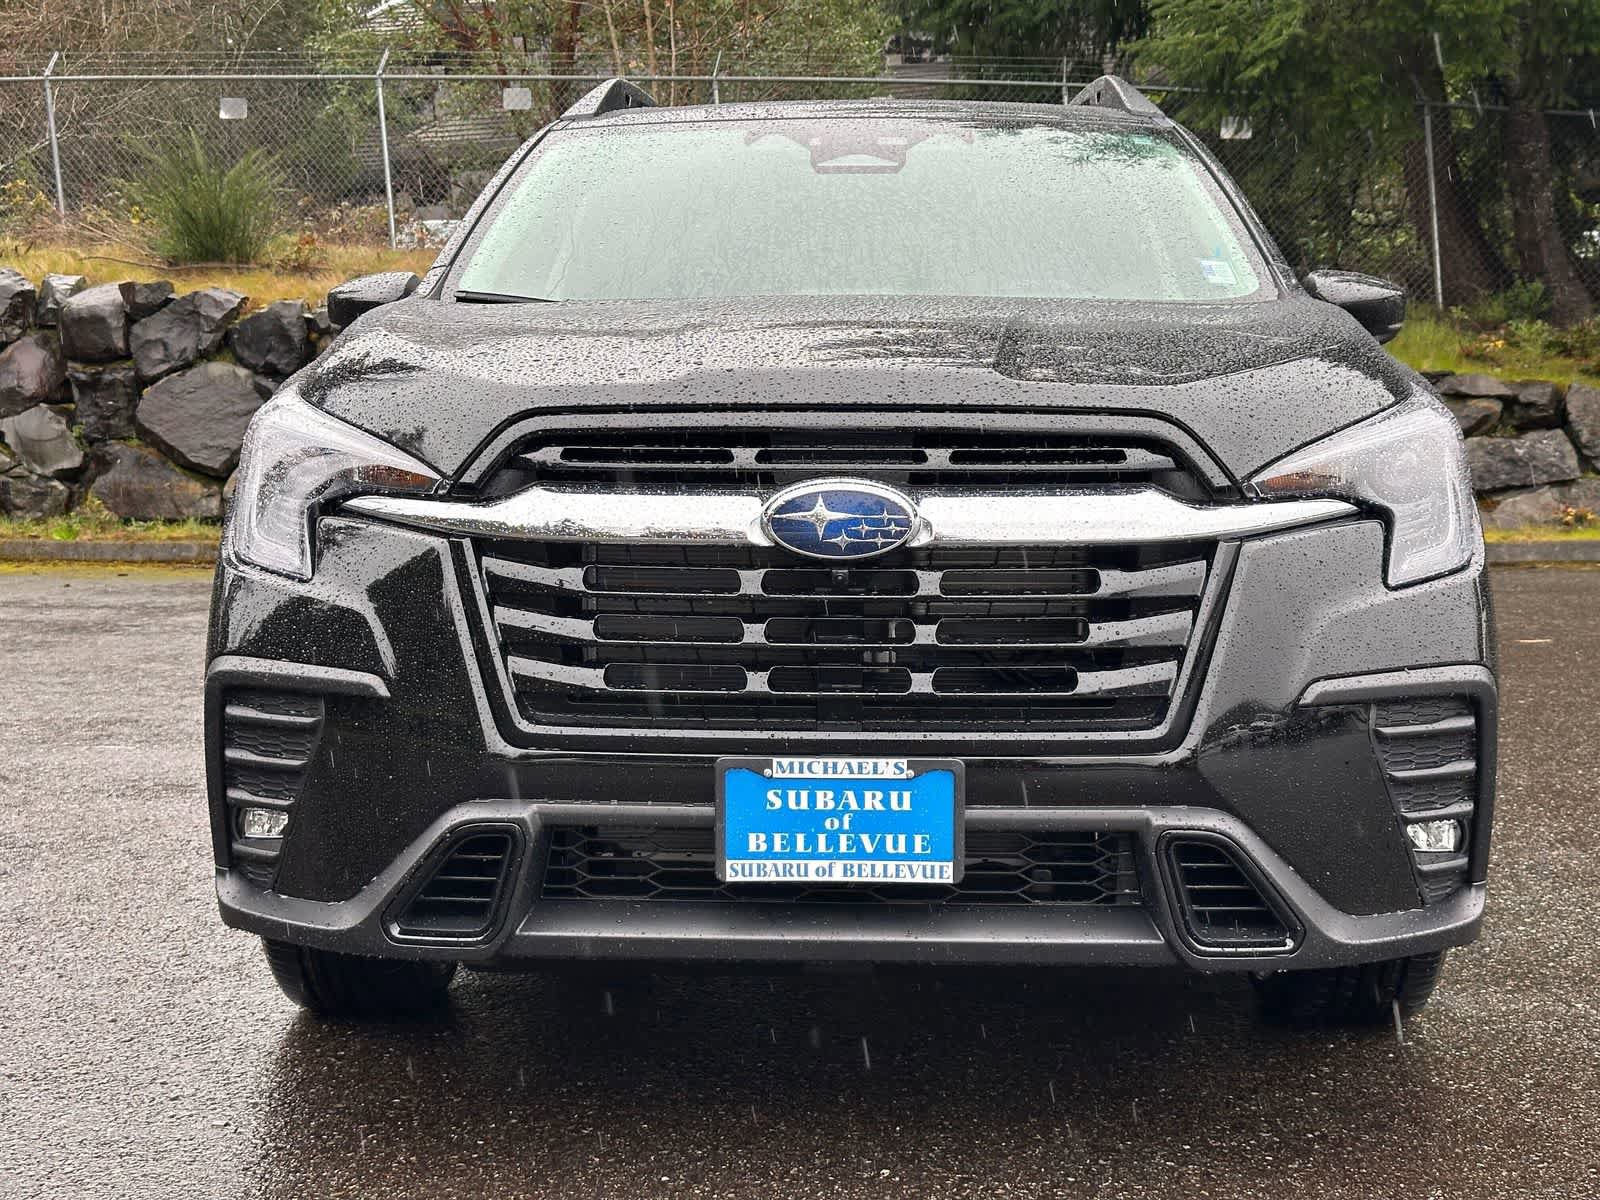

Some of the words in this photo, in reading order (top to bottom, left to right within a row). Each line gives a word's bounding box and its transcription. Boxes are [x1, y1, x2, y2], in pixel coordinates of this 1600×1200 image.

[775, 760, 906, 776] MICHAEL'S
[766, 789, 913, 811] SUBARU
[824, 813, 853, 831] of
[747, 832, 932, 854] BELLEVUE
[729, 862, 809, 878] SUBARU
[815, 862, 837, 879] of
[842, 863, 951, 880] BELLEVUE
